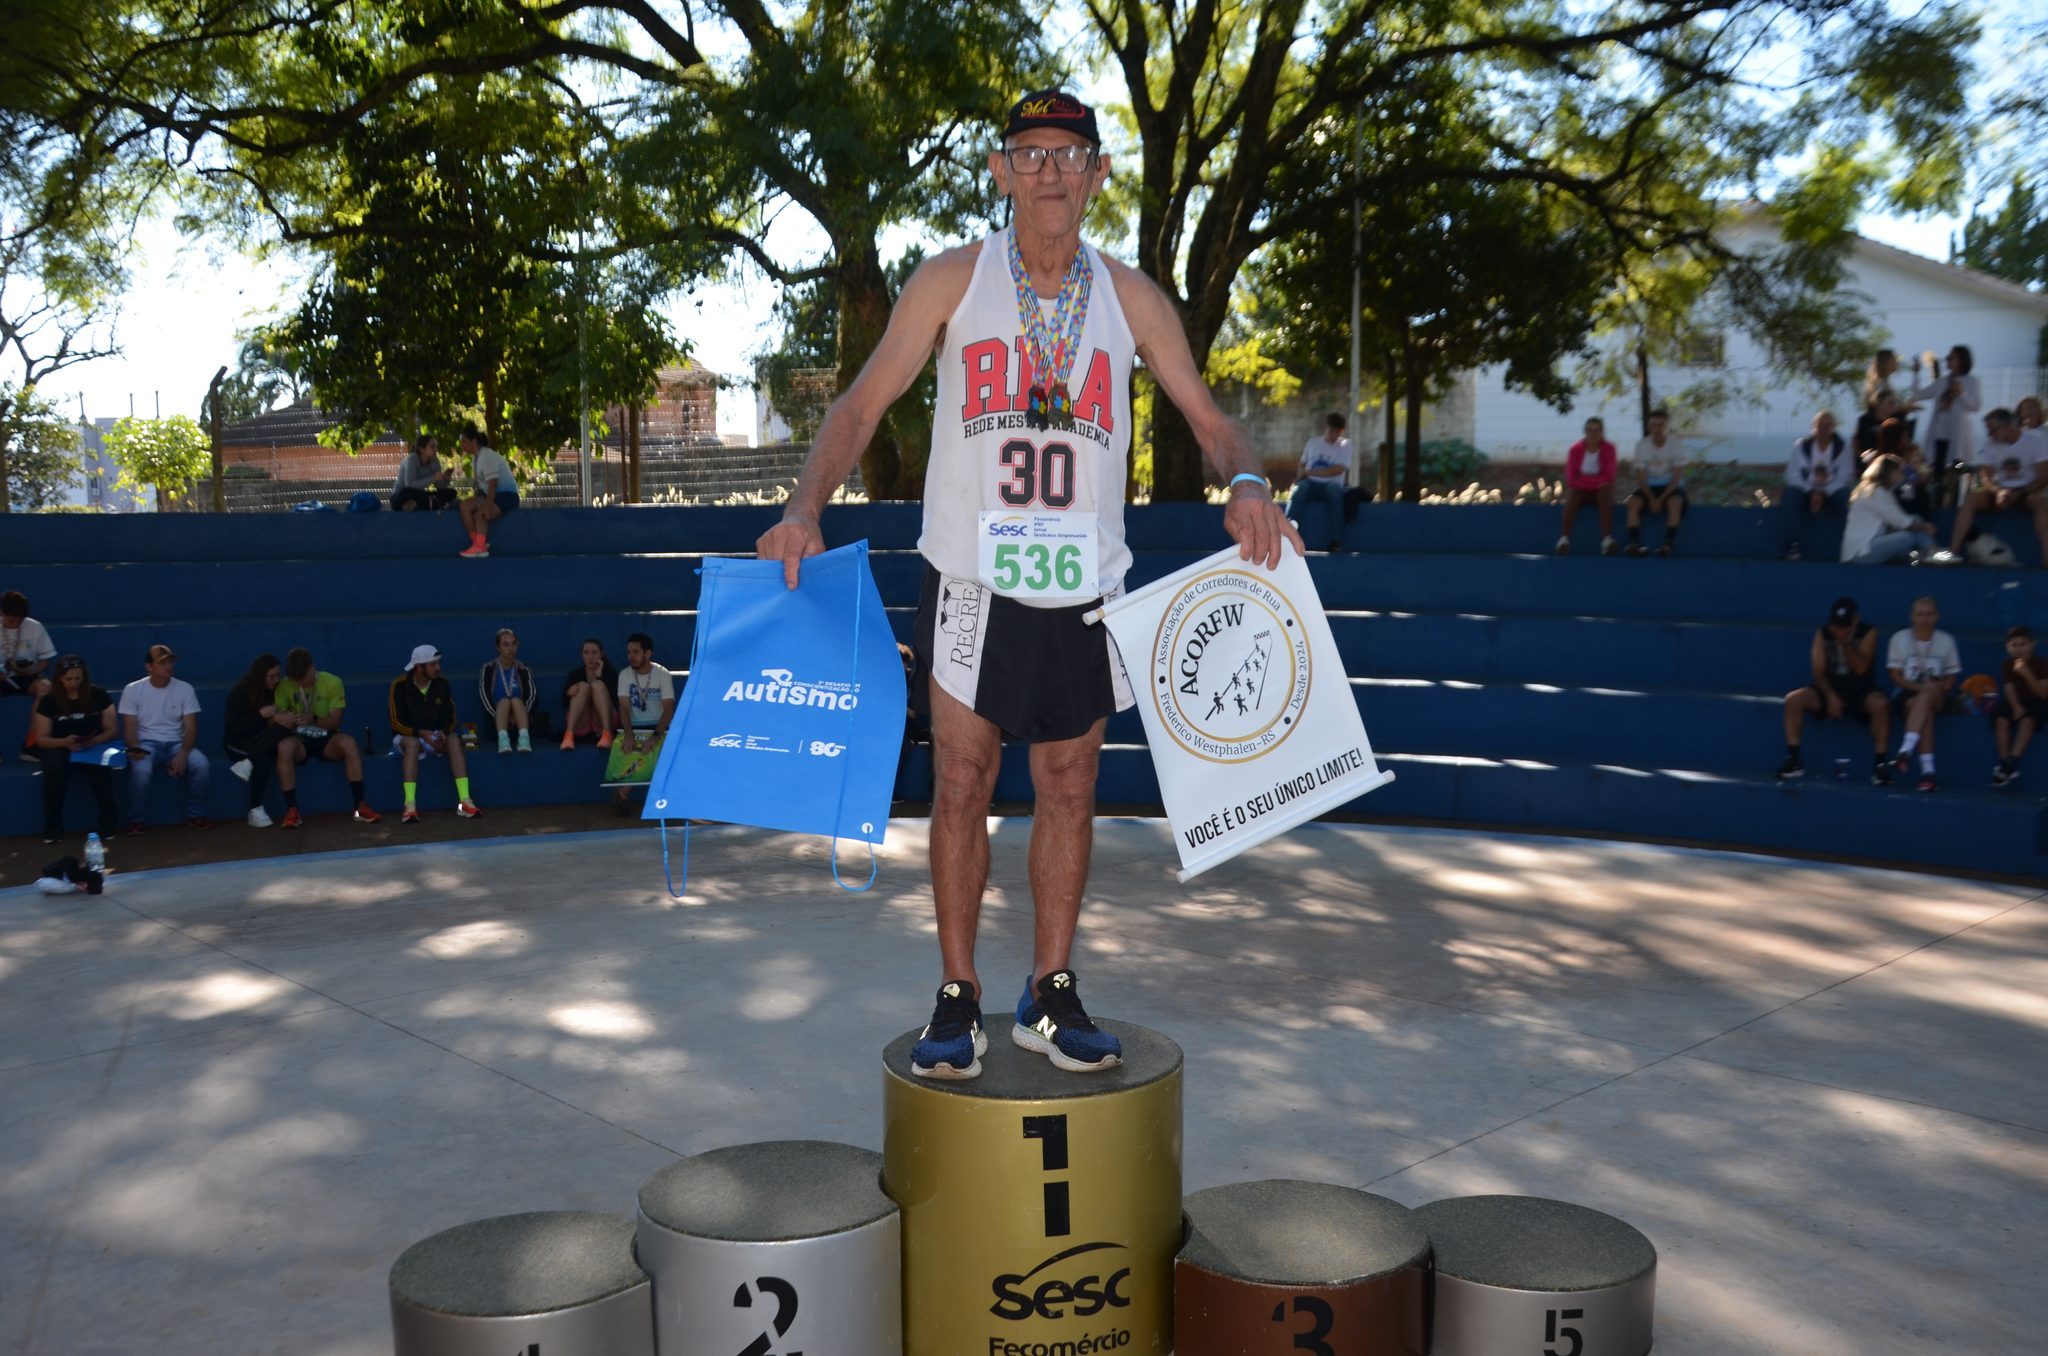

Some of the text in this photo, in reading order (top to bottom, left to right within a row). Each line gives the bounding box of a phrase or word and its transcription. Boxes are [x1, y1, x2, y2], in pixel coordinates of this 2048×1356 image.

[964, 415, 995, 439] REDE
[999, 437, 1077, 511] 30
[988, 522, 1028, 537] Sesc
[993, 543, 1083, 591] 536
[1157, 575, 1282, 666] Associação de Corredores de Rua
[1180, 603, 1245, 697] ACORFW
[1290, 640, 1308, 711] Desde 2024
[722, 680, 858, 710] Autismo
[793, 681, 850, 692] CONSCIENTIZAÇÃO
[1160, 692, 1193, 742] Frederico
[809, 741, 841, 758] 80
[1184, 747, 1365, 849] VOCÊ É O SEU ÚNICO LIMITE!
[1023, 1114, 1071, 1237] 1
[733, 1276, 799, 1356] 2
[989, 1257, 1131, 1320] Sesc
[989, 1328, 1131, 1356] Fecomércio
[1271, 1296, 1335, 1356] 3
[1543, 1308, 1584, 1356] 5
